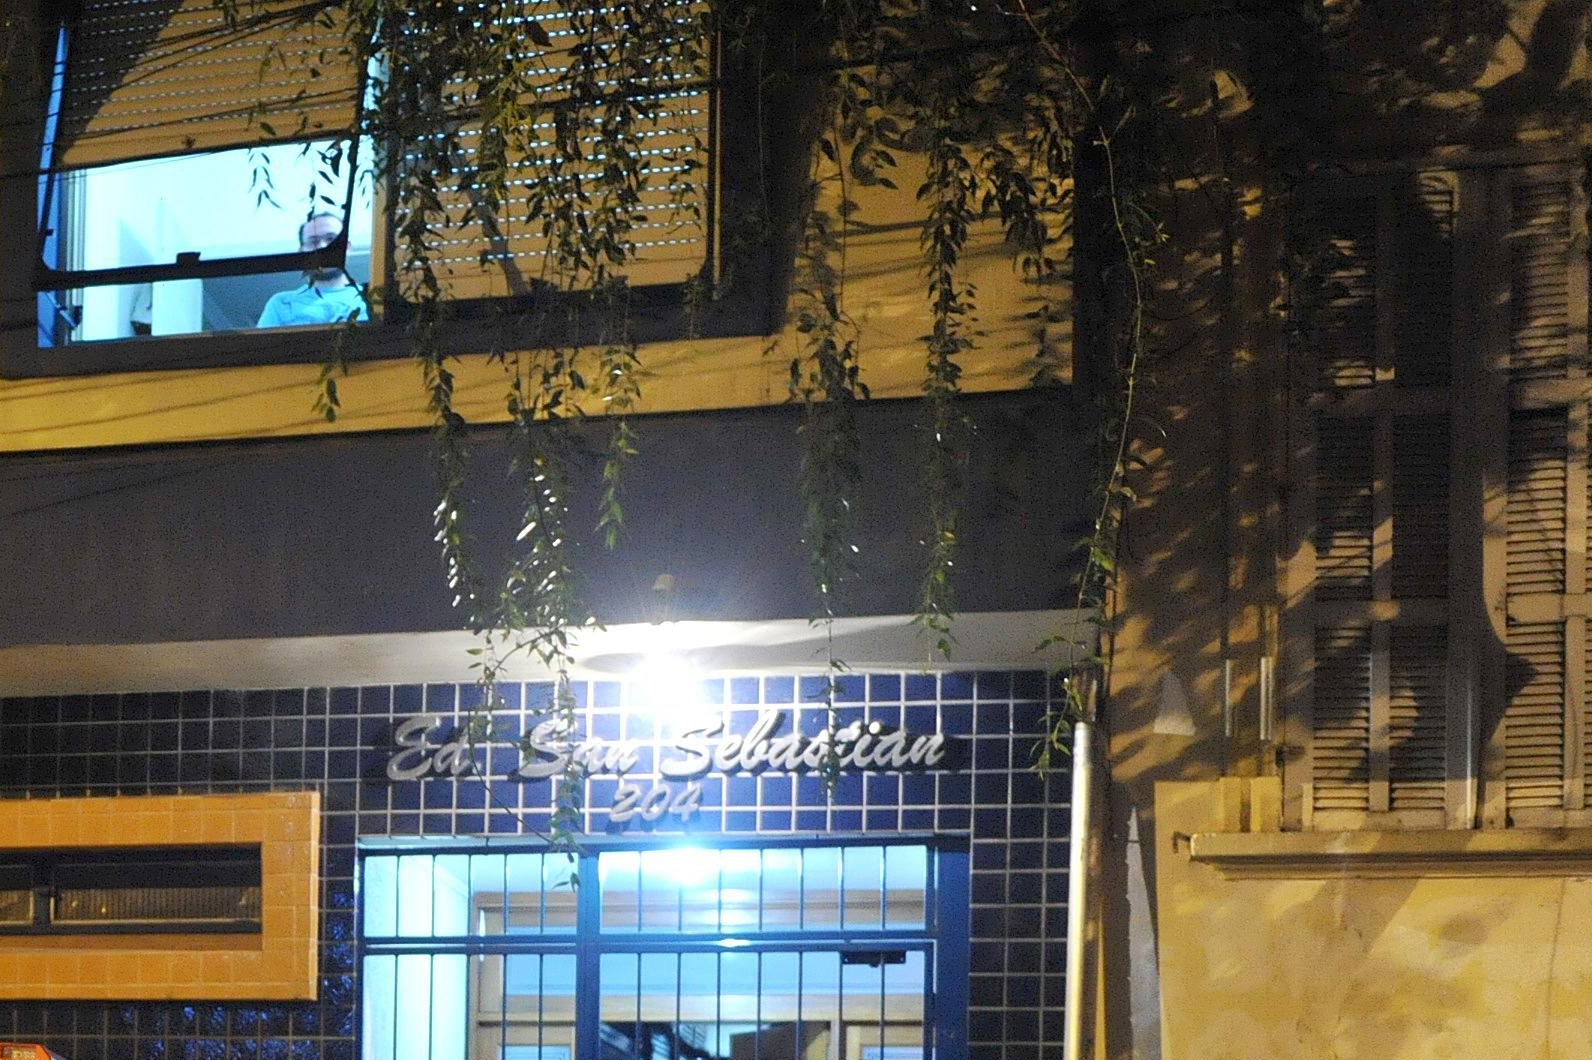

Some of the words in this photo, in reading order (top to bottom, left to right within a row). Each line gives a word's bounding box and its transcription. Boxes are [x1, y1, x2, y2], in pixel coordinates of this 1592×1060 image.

[519, 716, 639, 778] San
[660, 708, 946, 776] Sebastian
[609, 781, 702, 823] 204
